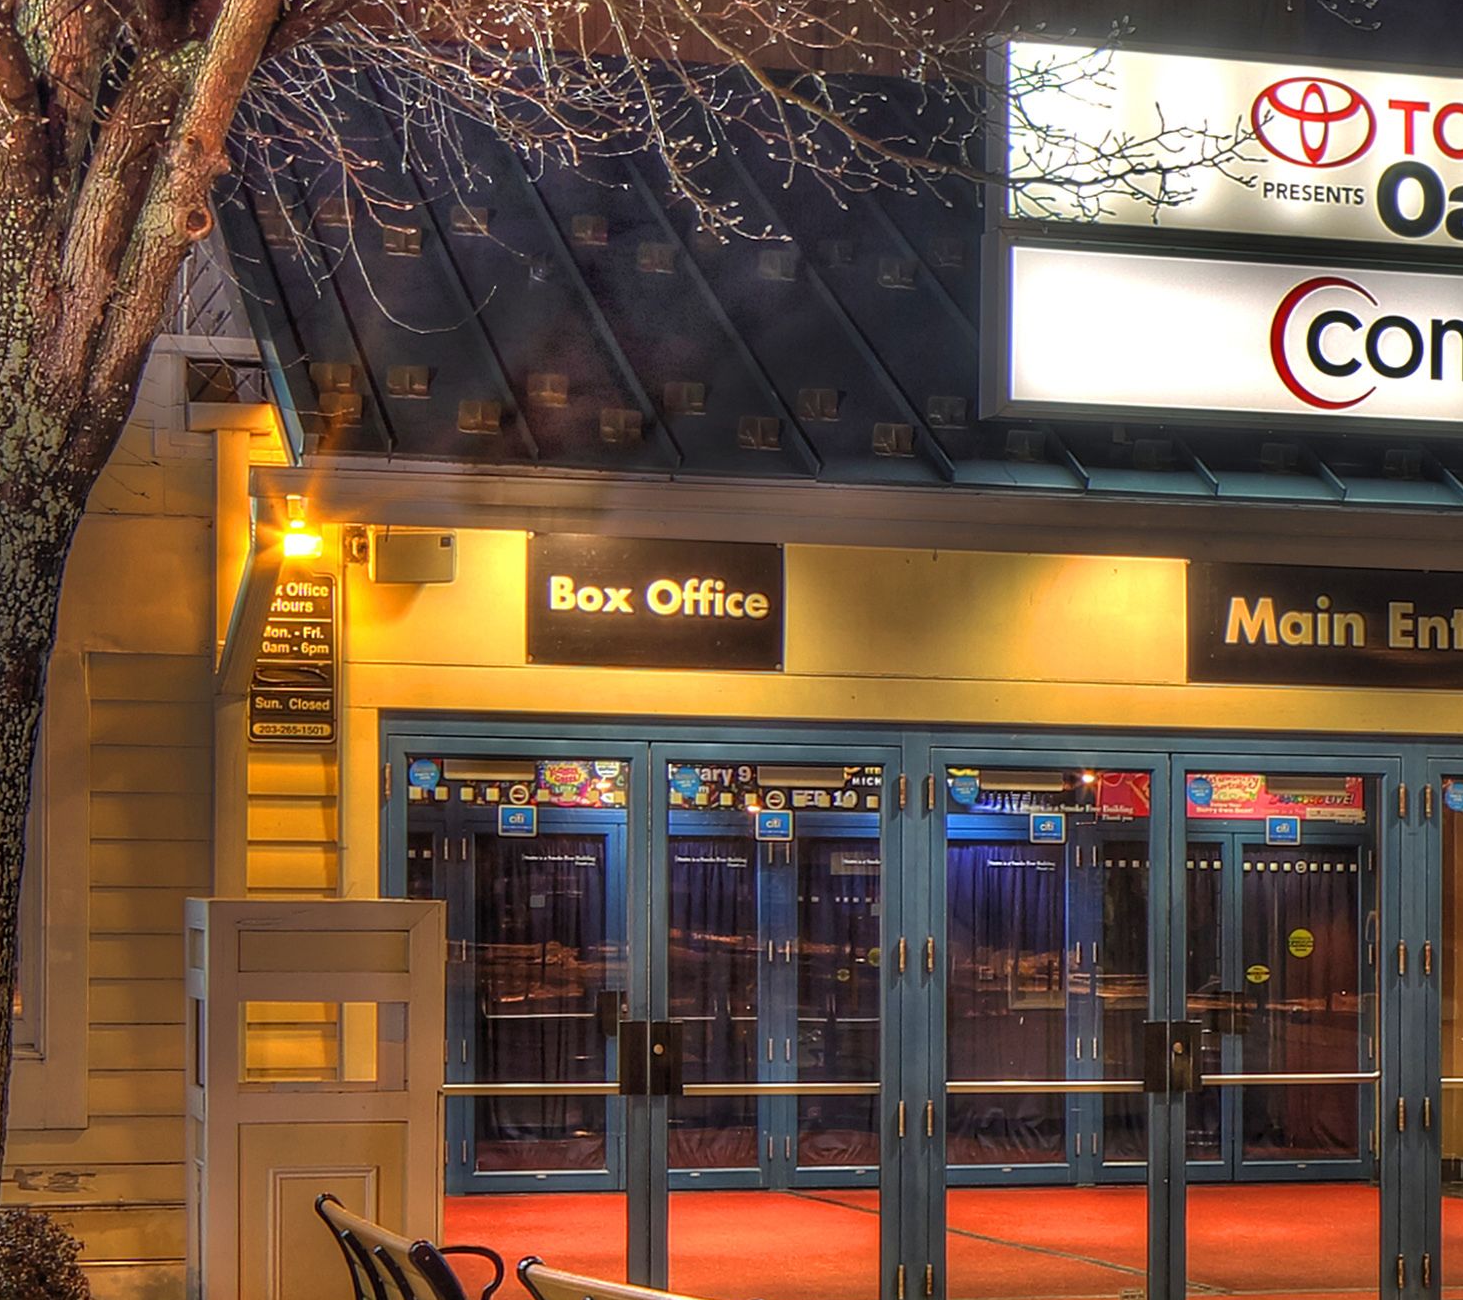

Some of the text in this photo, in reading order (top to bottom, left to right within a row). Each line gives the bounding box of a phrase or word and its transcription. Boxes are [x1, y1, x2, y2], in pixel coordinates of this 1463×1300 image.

[1263, 182, 1365, 206] PRESENTS
[286, 582, 330, 597] Office
[550, 575, 770, 618] Box Office
[1225, 595, 1366, 647] Main
[303, 627, 324, 639] Fri.
[301, 642, 330, 656] 6pm
[255, 696, 331, 711] Sun. Closed
